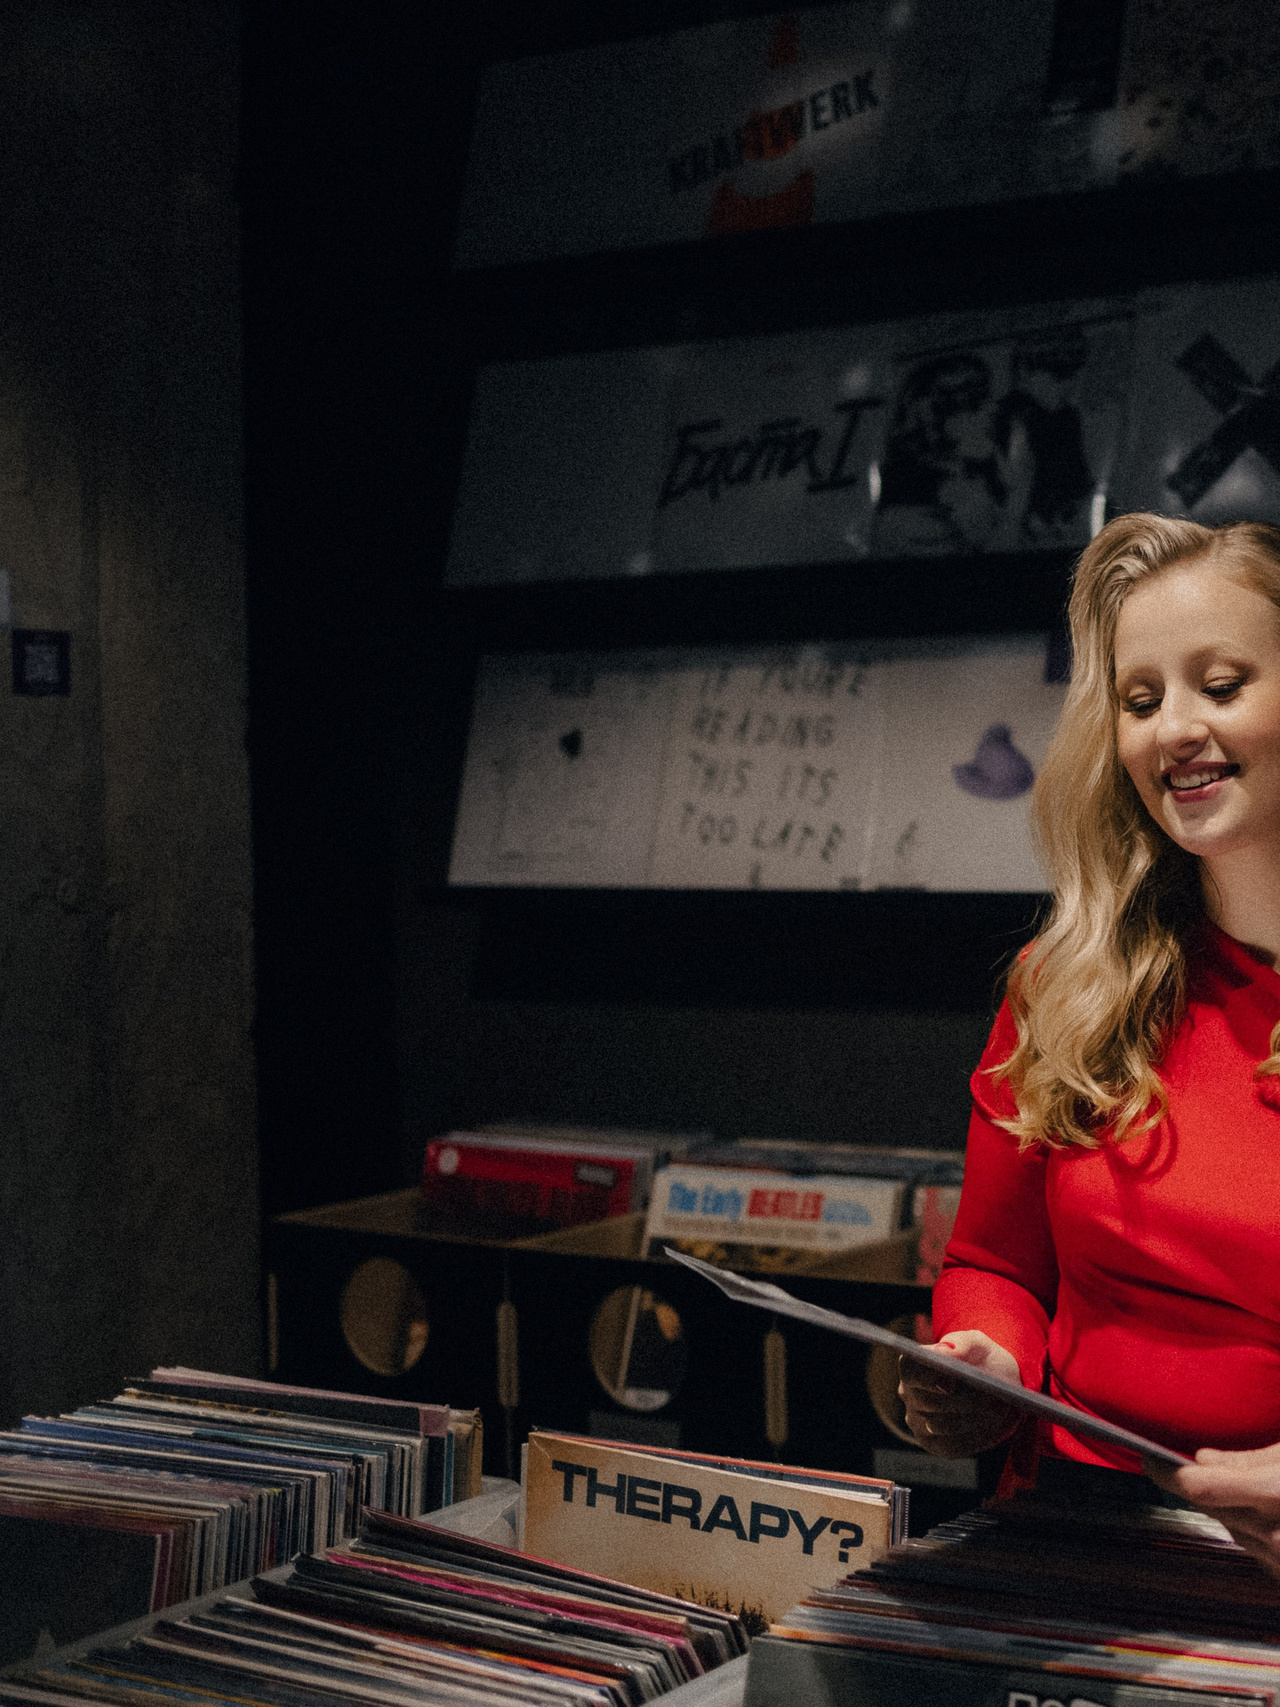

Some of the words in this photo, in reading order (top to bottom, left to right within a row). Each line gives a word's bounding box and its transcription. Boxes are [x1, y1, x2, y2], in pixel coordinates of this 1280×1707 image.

[669, 71, 878, 192] KRAFTWERK
[690, 706, 836, 747] READING
[689, 751, 753, 797] THIS
[778, 763, 839, 807] ITS
[680, 802, 738, 844] TOO
[751, 822, 845, 862] LATE
[552, 1460, 864, 1563] THERAPY?
